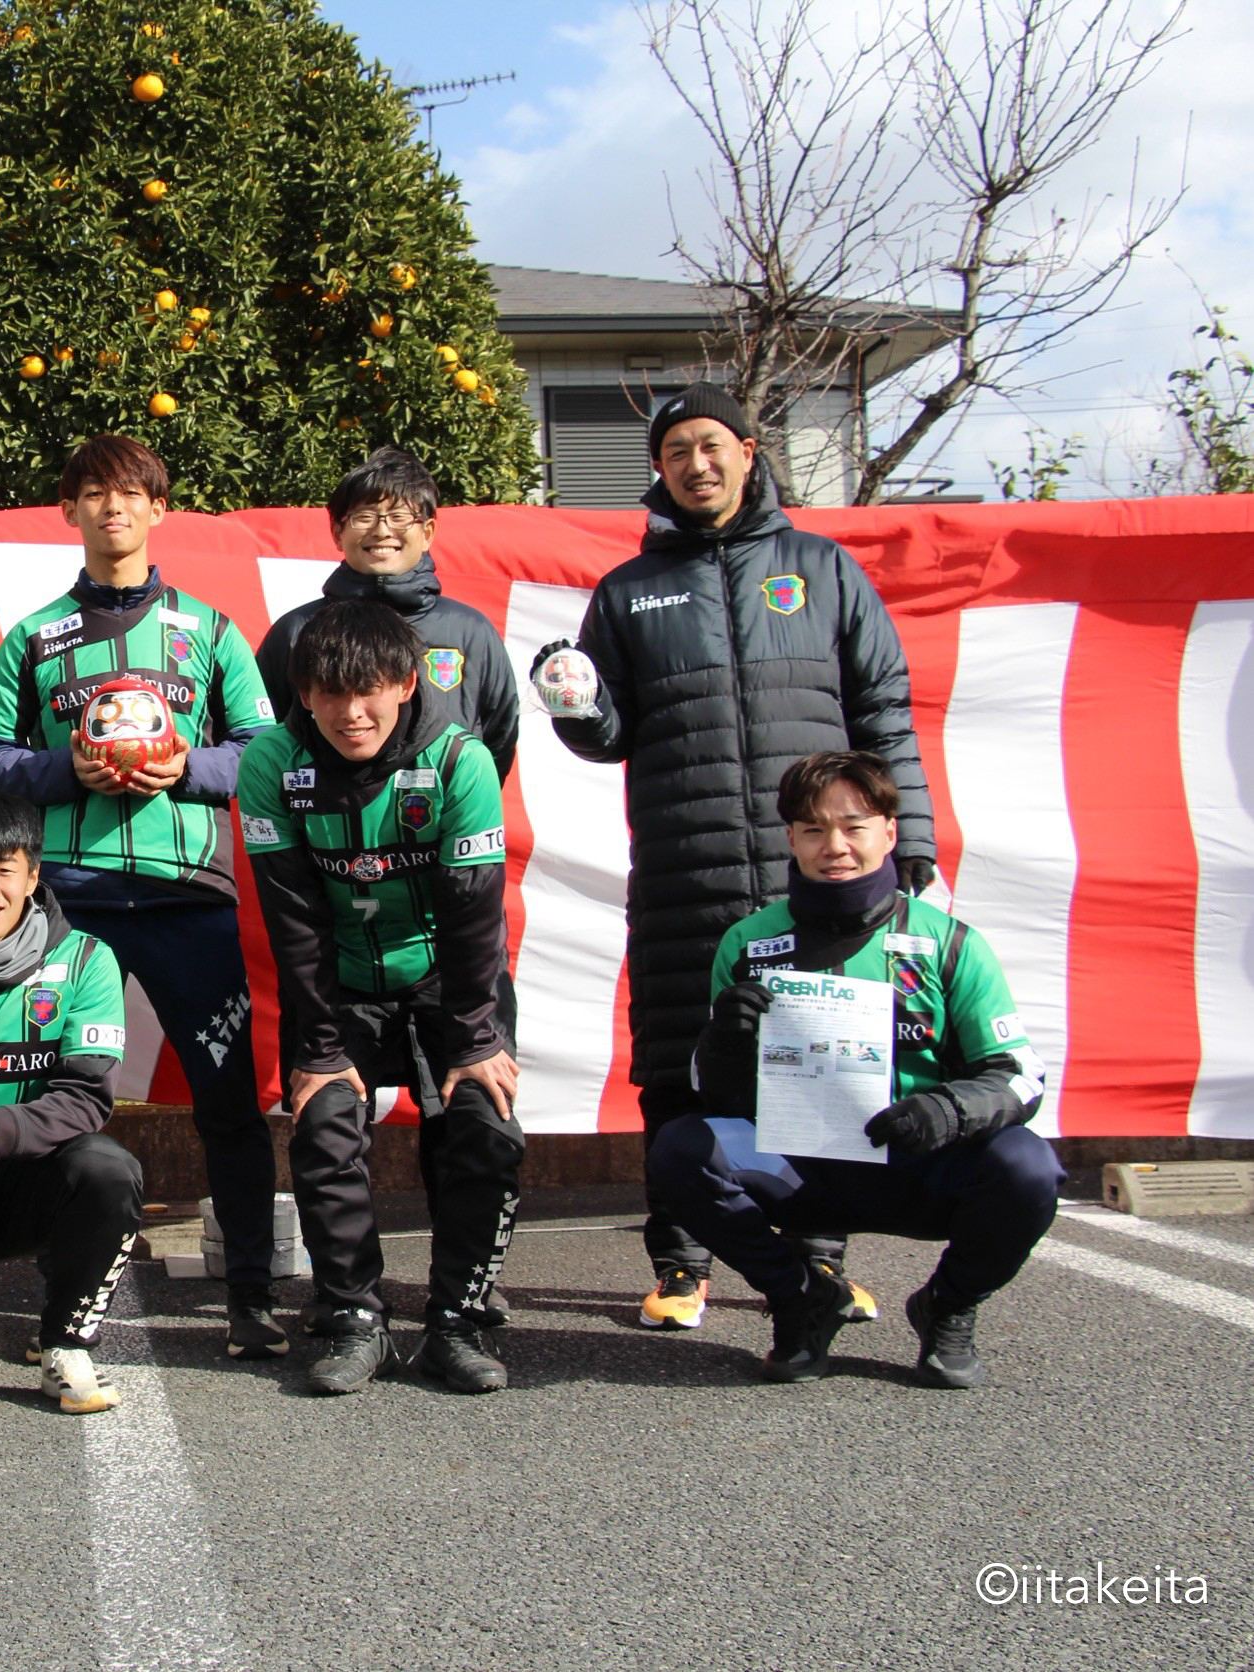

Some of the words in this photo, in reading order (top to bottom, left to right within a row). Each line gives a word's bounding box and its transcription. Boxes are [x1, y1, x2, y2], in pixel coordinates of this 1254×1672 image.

[631, 592, 691, 614] ATHLETA
[44, 636, 84, 656] ATHLETA
[383, 850, 438, 871] TARO
[351, 898, 380, 923] 7
[767, 975, 818, 997] GREEN
[821, 978, 856, 1001] FLAG
[6, 1050, 56, 1073] TARO
[78, 1232, 137, 1340] ATHLETA
